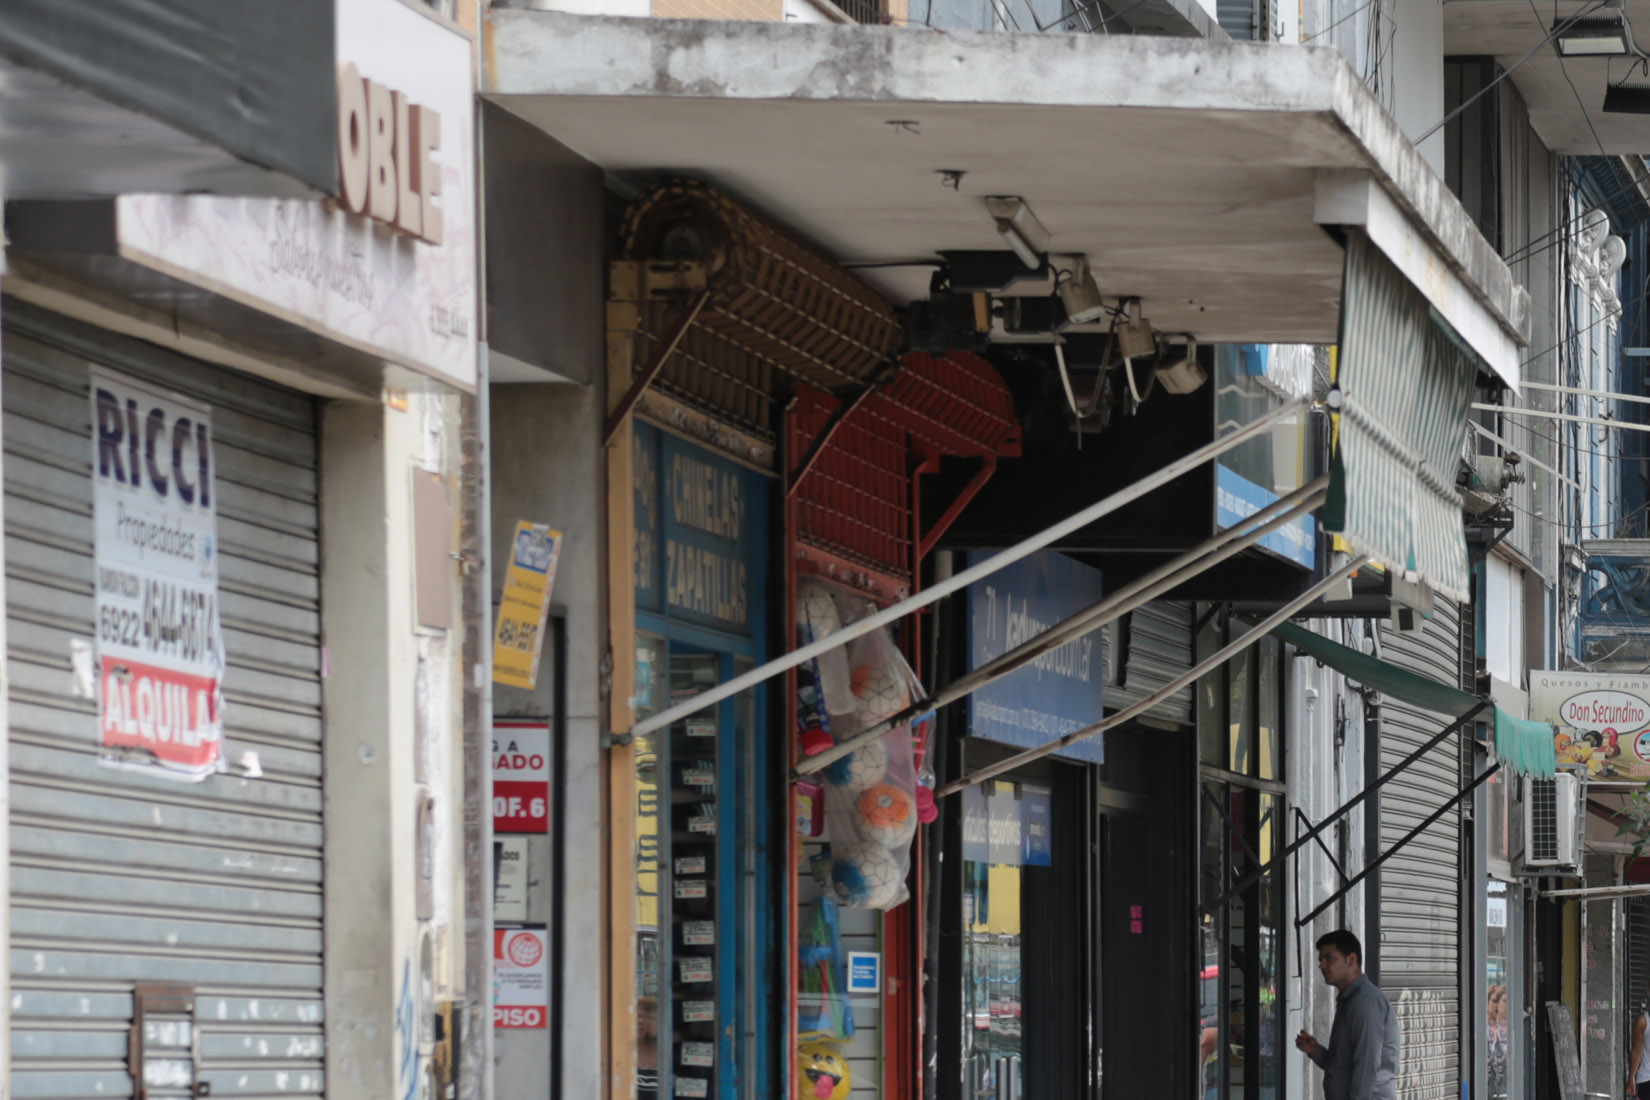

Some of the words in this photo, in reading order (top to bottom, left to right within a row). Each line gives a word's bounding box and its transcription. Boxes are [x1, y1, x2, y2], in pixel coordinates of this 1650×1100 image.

[95, 387, 211, 507] RICCI
[673, 452, 740, 540] CHINELAS
[117, 500, 196, 560] Propiedades
[667, 539, 747, 625] ZAPATILLAS
[101, 605, 140, 647] 6922
[105, 672, 218, 748] ALQUILA
[1541, 678, 1589, 687] Quesos
[1596, 682, 1602, 690] y
[1569, 702, 1590, 722] Don
[1592, 700, 1645, 724] Secundino
[530, 797, 545, 818] 6
